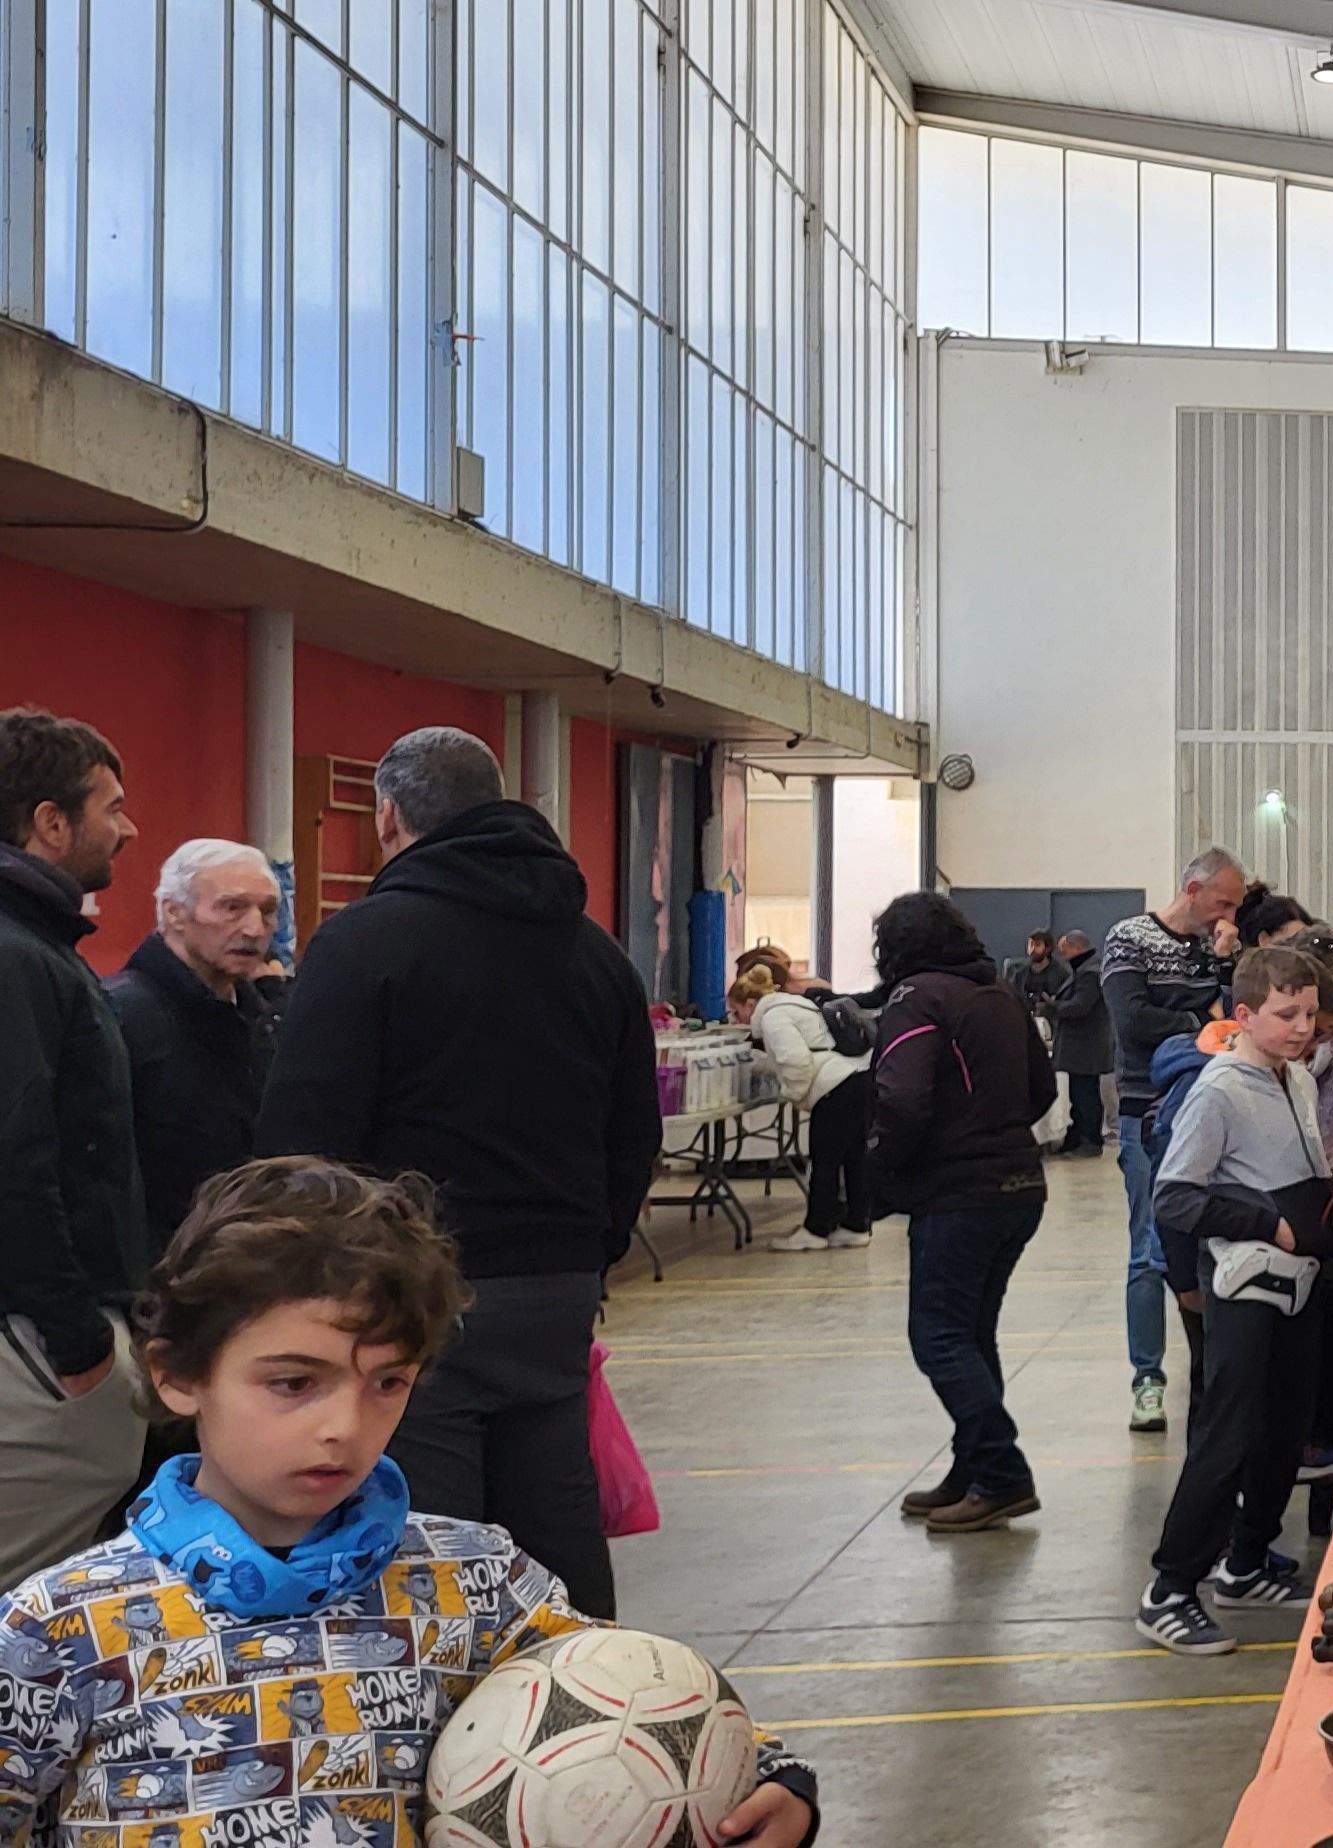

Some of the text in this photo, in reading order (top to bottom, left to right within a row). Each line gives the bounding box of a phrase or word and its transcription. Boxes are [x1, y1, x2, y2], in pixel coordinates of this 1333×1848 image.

[0, 1678, 56, 1717] OME
[345, 1668, 421, 1707] HOME
[358, 1695, 423, 1730] RUN!
[200, 1800, 297, 1848] HOME
